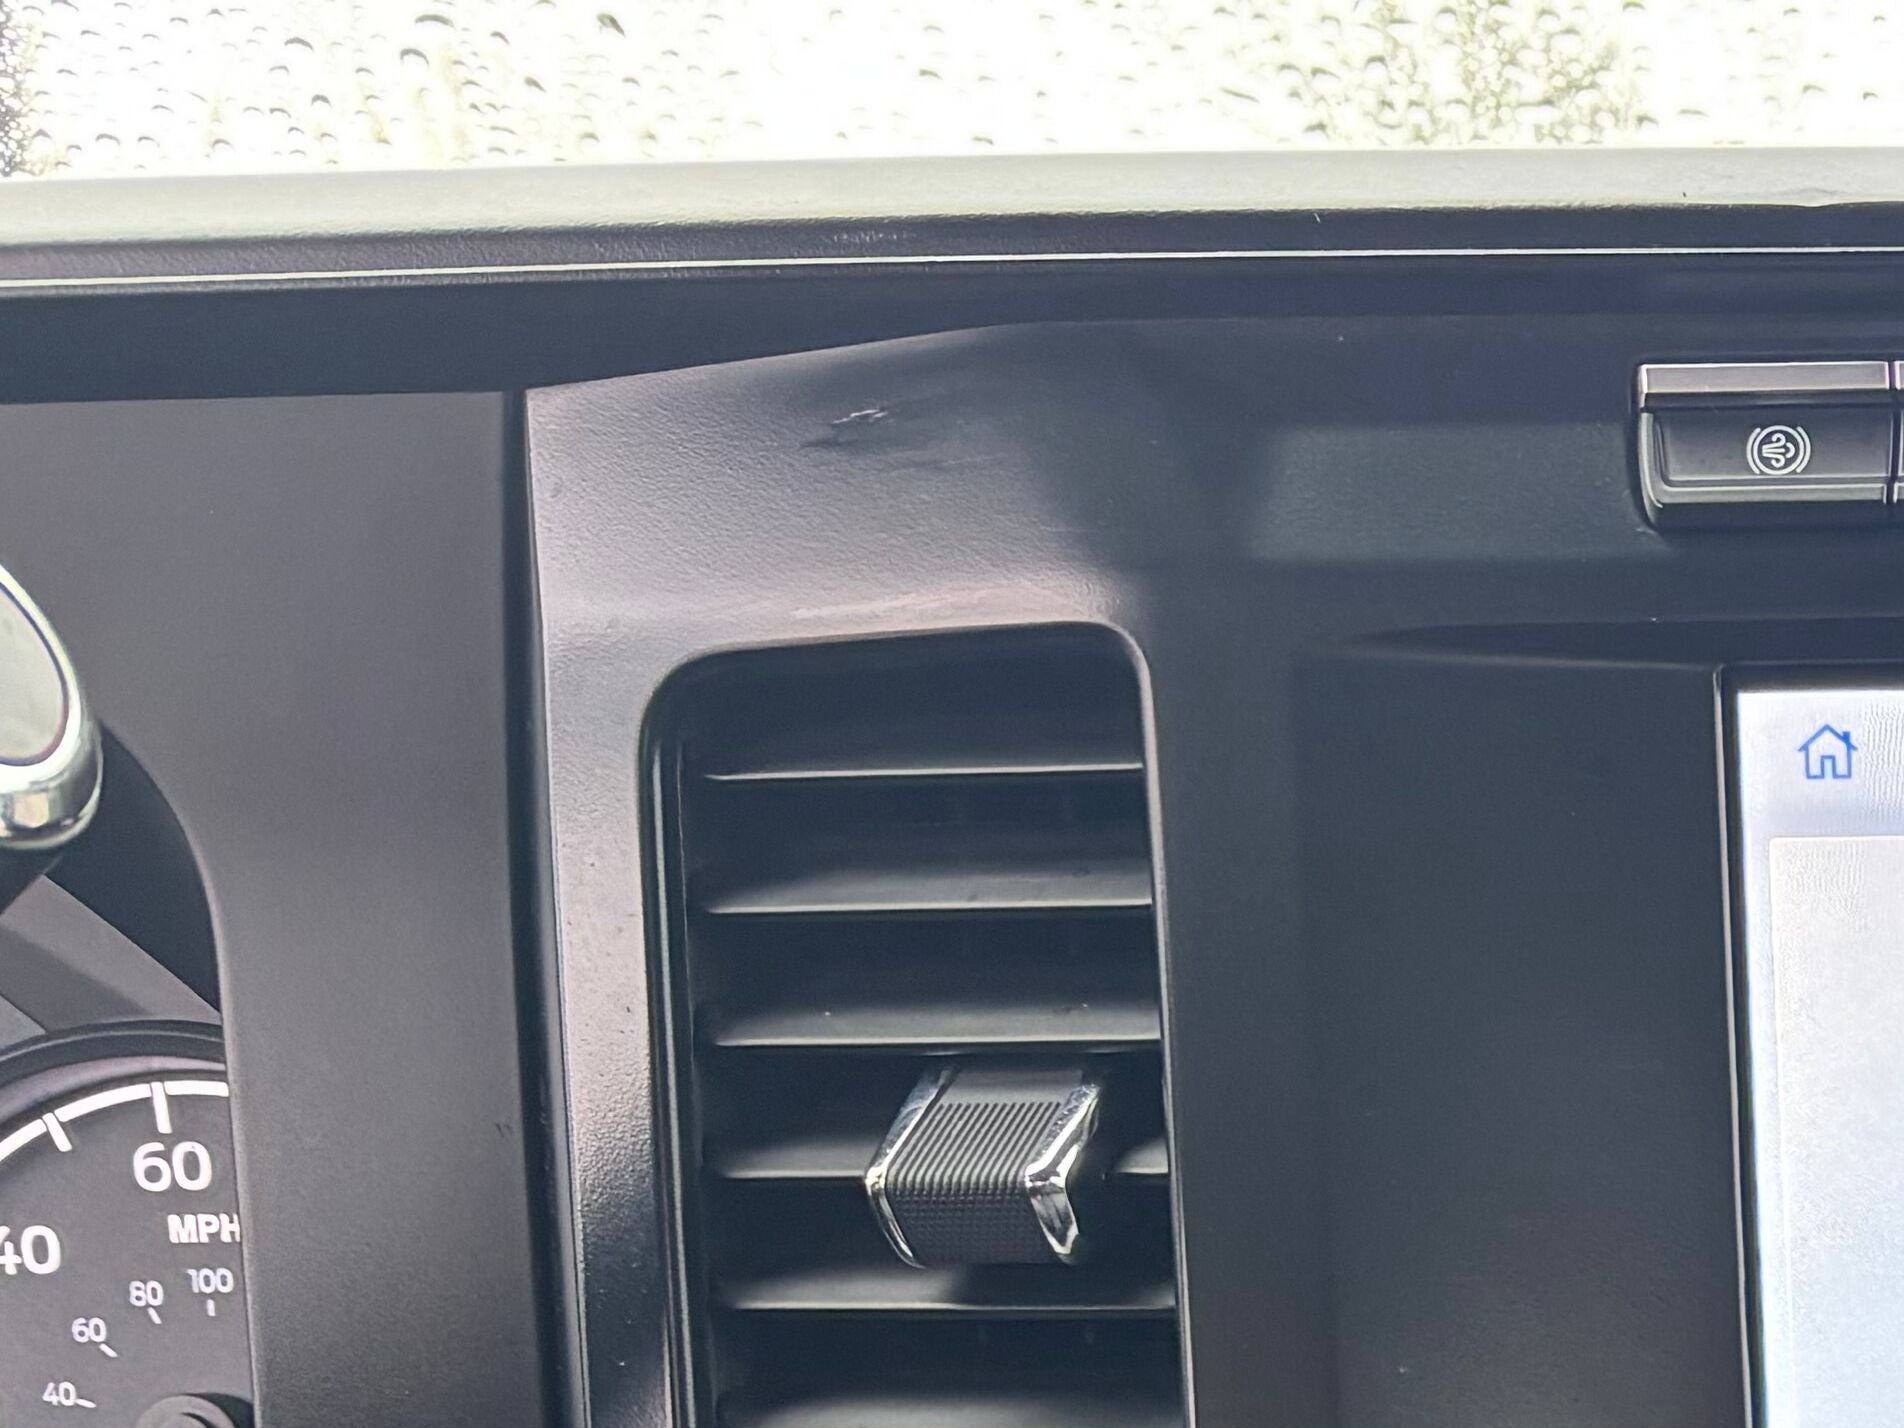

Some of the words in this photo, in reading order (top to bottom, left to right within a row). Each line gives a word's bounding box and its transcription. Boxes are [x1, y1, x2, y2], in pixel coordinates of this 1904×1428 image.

[133, 1141, 212, 1192] 60
[167, 1213, 241, 1244] MPH
[129, 1280, 164, 1307] 80
[186, 1267, 234, 1294] 100
[71, 1317, 107, 1343] 60
[42, 1381, 77, 1406] 40
